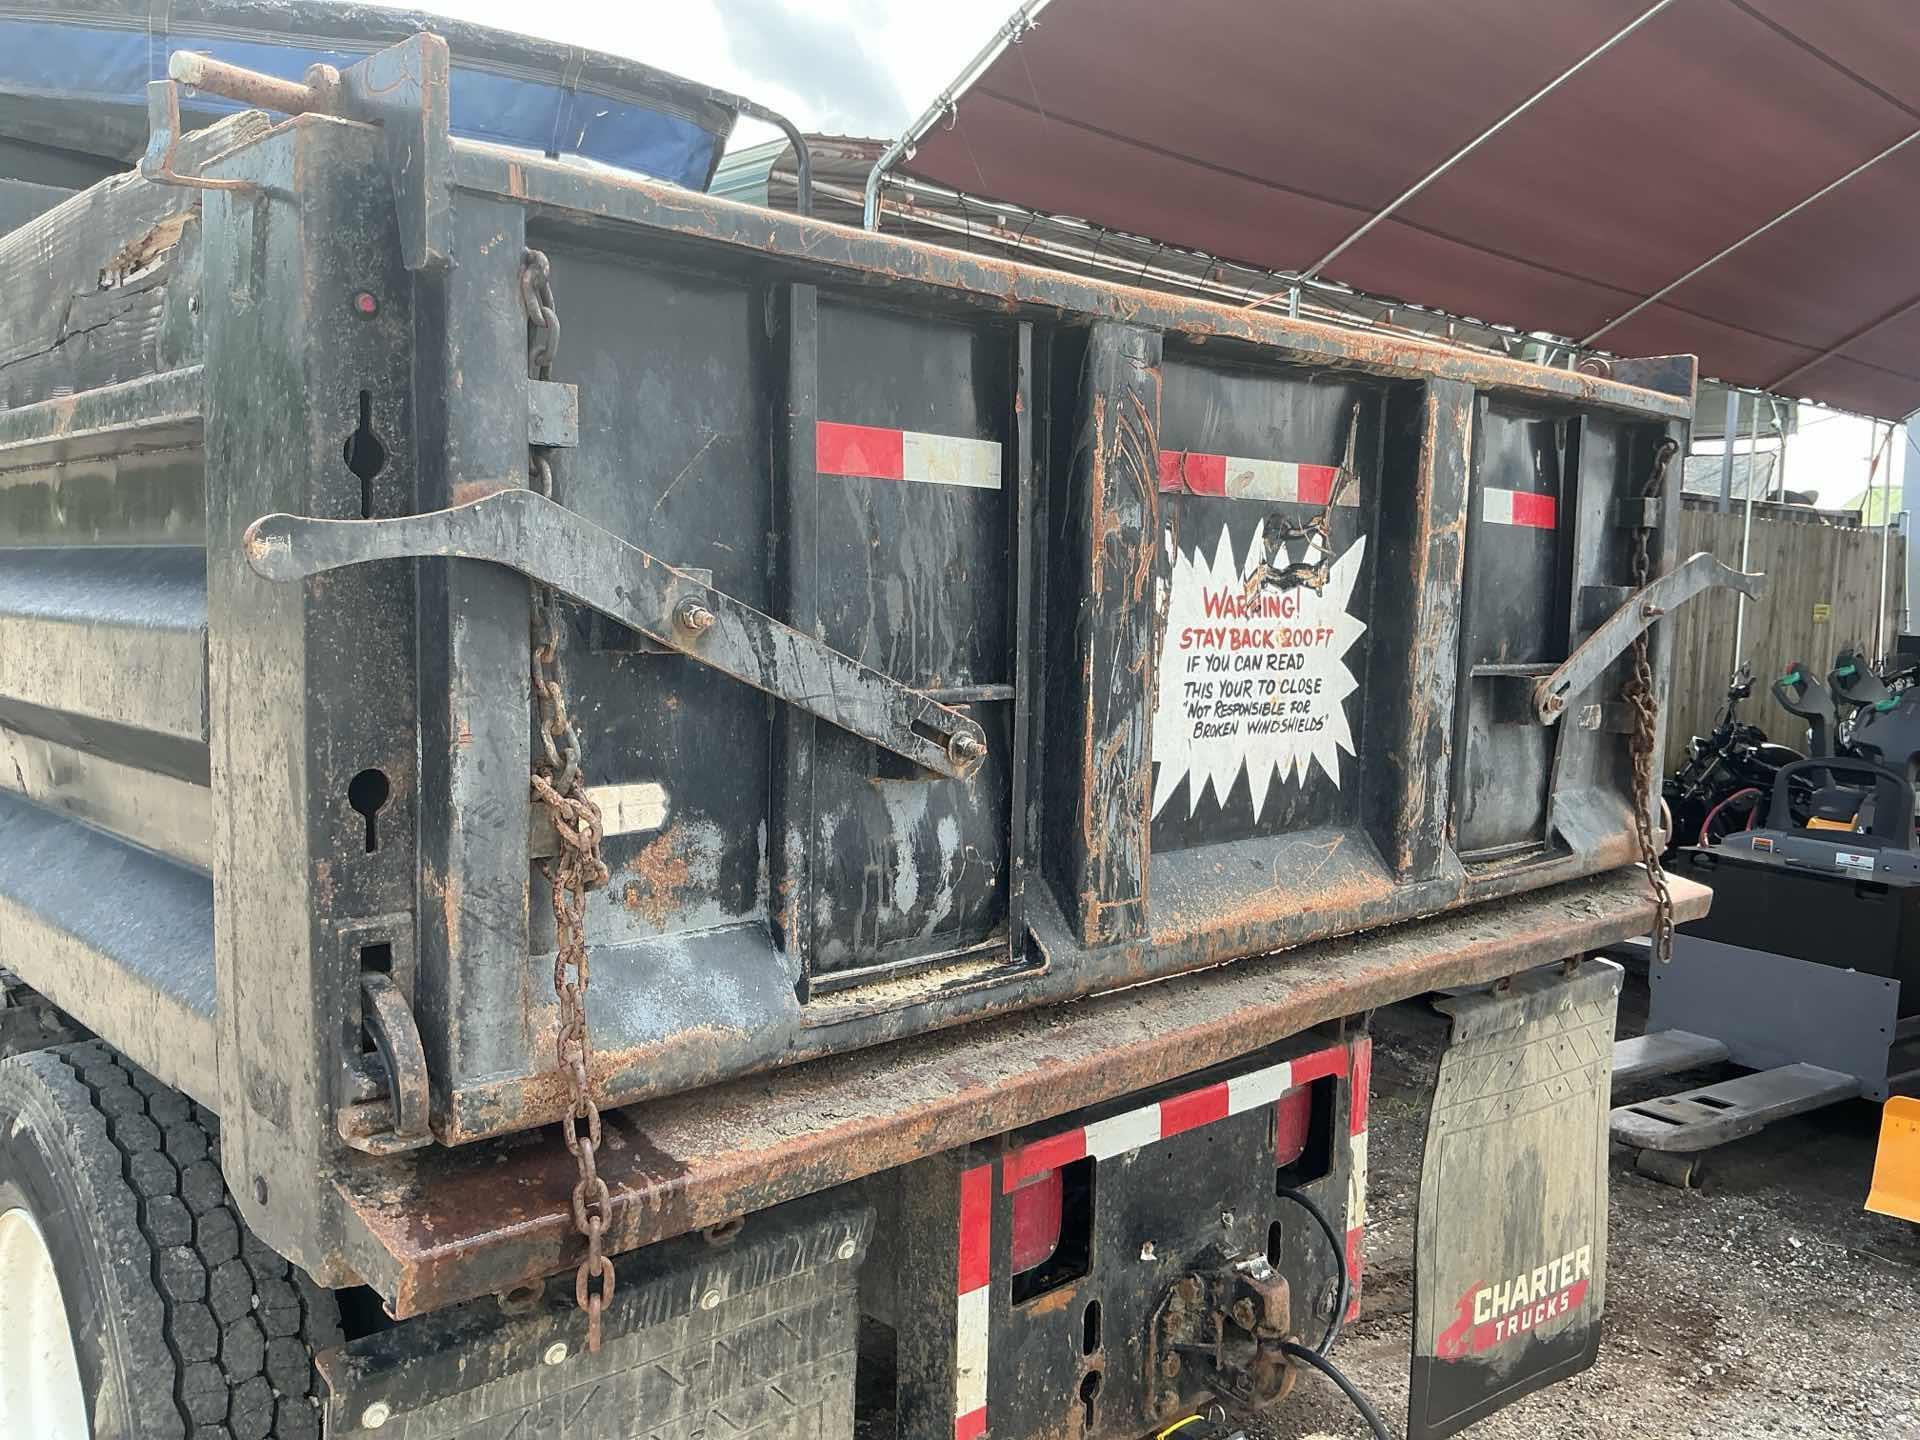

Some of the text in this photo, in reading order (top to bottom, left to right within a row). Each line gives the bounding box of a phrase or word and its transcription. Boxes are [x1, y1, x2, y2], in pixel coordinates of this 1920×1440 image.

[1180, 628, 1335, 650] STAY BACK 200 FT
[1187, 653, 1305, 673] IF YOU CAN READ
[1184, 678, 1322, 699] THIS YOUR TO CLOSE
[1214, 700, 1285, 717] RESPONSIBLE
[1290, 700, 1311, 714] FOR
[1193, 721, 1239, 739] BROKEN
[1474, 1244, 1590, 1325] CHARTER
[1496, 1290, 1569, 1341] TRUCKS
